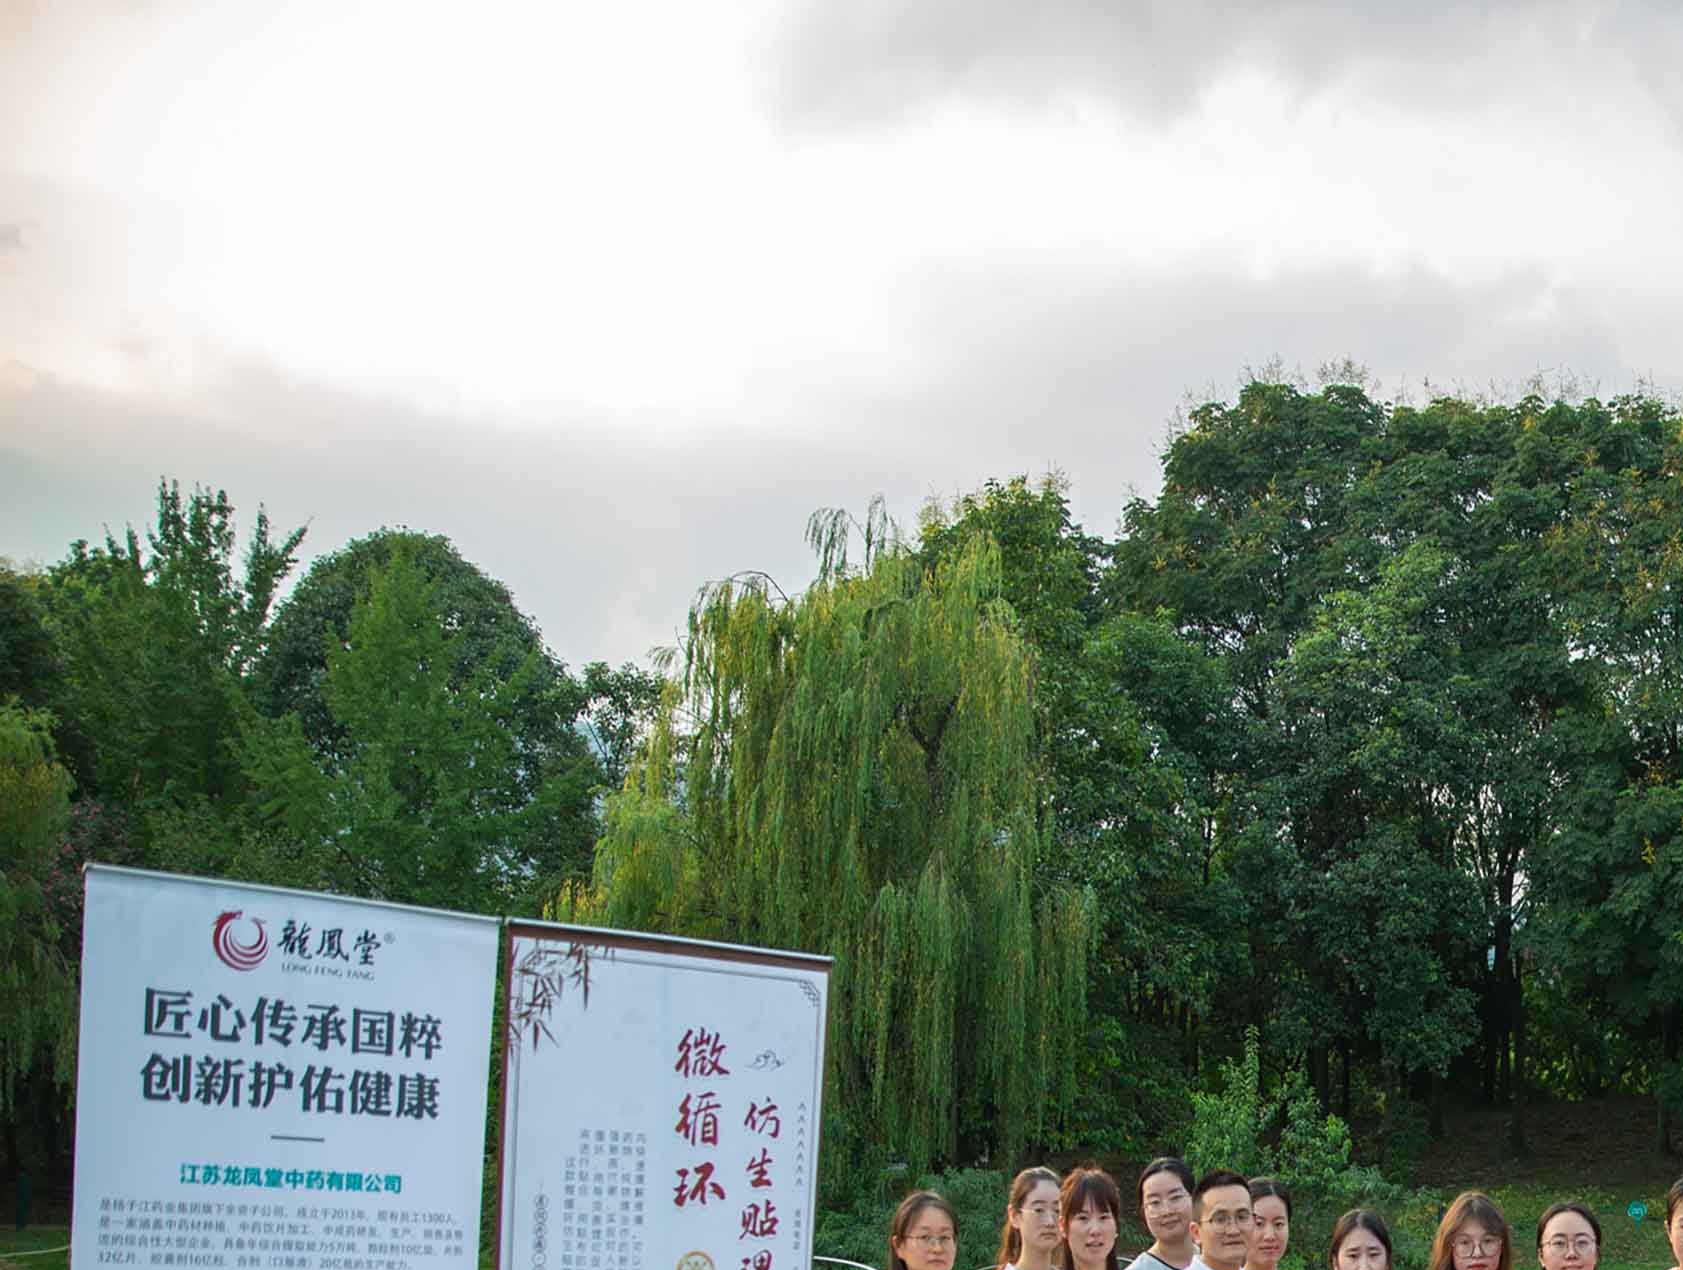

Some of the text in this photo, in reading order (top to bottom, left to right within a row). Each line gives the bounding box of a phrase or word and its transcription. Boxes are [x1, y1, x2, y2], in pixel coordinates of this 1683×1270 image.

[144, 987, 442, 1060] 匠心传承国粹
[140, 1053, 440, 1120] 创新护佑健康
[673, 1027, 731, 1209] 微循环
[180, 1163, 402, 1195] 江苏龙凤堂中药有限公司
